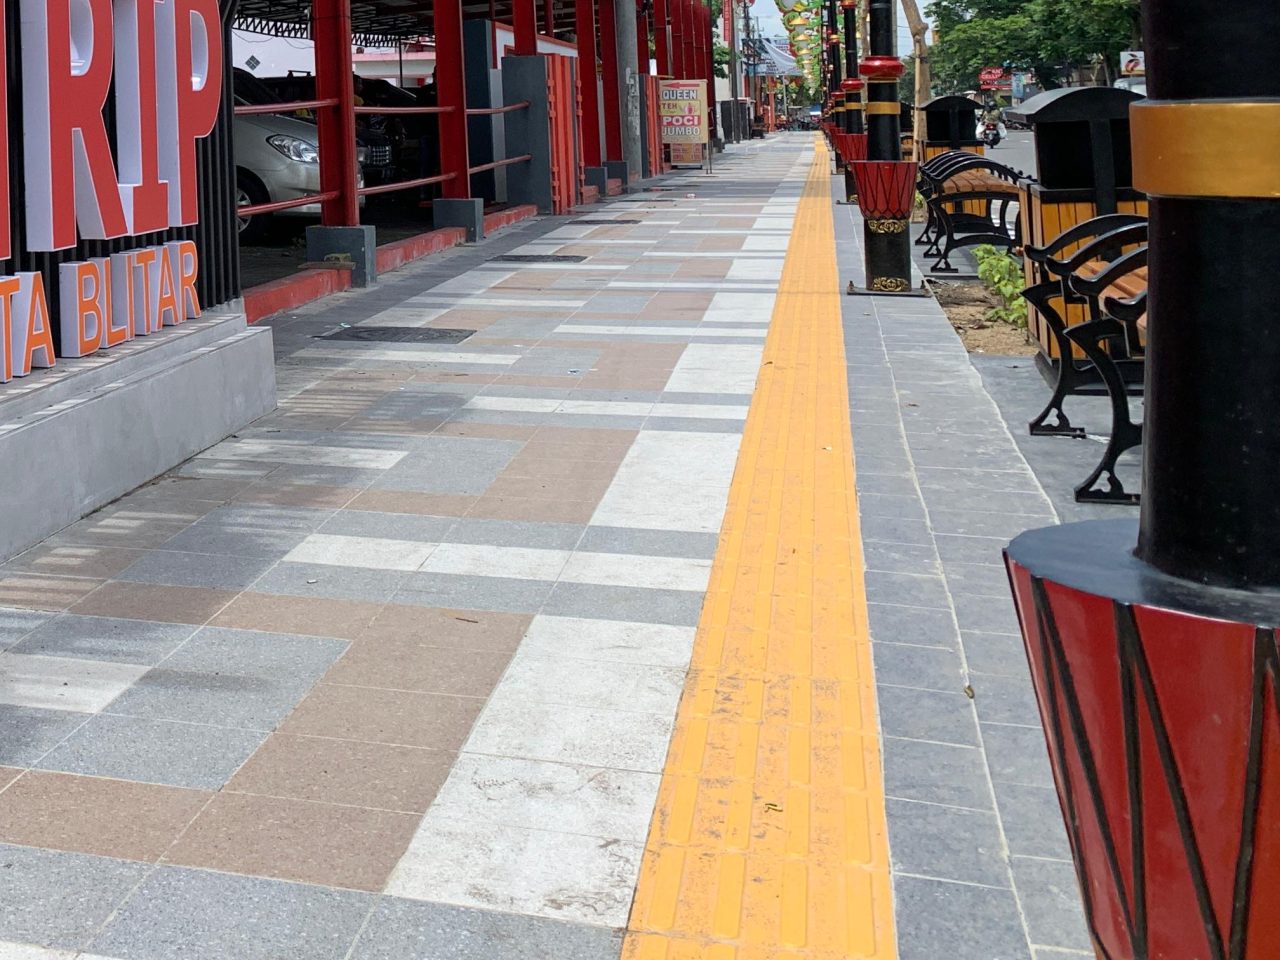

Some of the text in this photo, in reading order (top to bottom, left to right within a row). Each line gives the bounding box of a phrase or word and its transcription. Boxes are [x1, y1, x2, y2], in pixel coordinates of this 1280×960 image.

[662, 89, 697, 100] QUEEN
[662, 116, 699, 126] POCI
[662, 126, 700, 136] JUMBO
[59, 240, 201, 358] BLITAR
